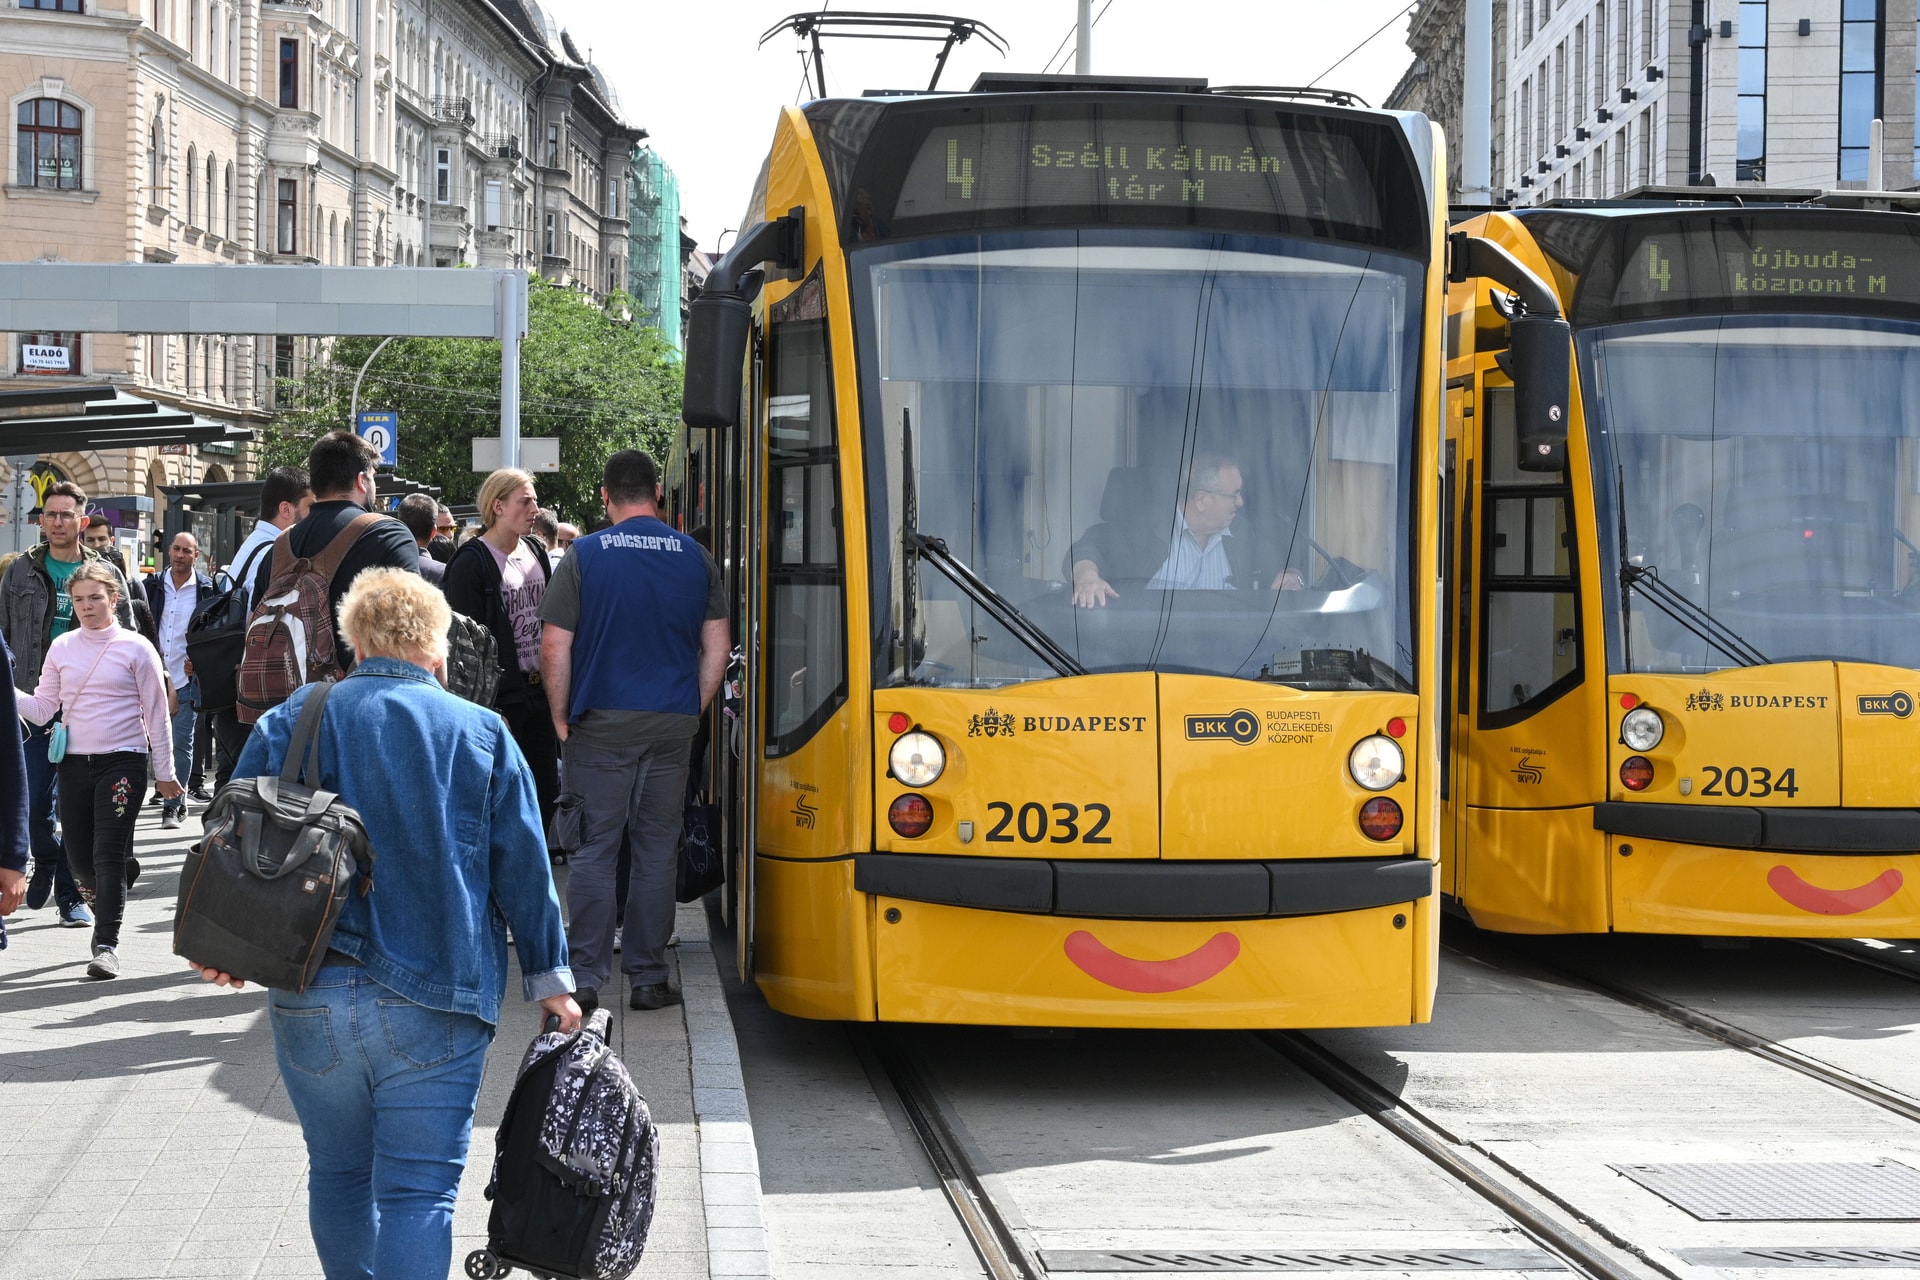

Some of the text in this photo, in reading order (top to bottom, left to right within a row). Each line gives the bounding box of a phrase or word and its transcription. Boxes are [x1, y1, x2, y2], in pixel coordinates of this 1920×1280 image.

[1032, 142, 1280, 173] Széll Kálmán
[947, 139, 975, 199] 4
[1107, 175, 1205, 201] tér M
[1649, 244, 1671, 291] 4
[1752, 246, 1873, 269] Újbuda-
[1735, 272, 1887, 293] központ M
[29, 348, 62, 357] ELADÓ
[600, 532, 683, 552] Polcszerviz
[1730, 695, 1828, 709] BUDAPEST
[1864, 700, 1889, 709] BKK
[1023, 716, 1147, 732] BUDAPEST
[1266, 711, 1320, 720] BUDAPESTI
[1194, 721, 1228, 733] BKK
[1267, 722, 1333, 732] KÖZLEKEDÉSI
[1268, 733, 1314, 744] KÖZPONT
[1700, 765, 1799, 798] 2034
[985, 801, 1112, 844] 2032
